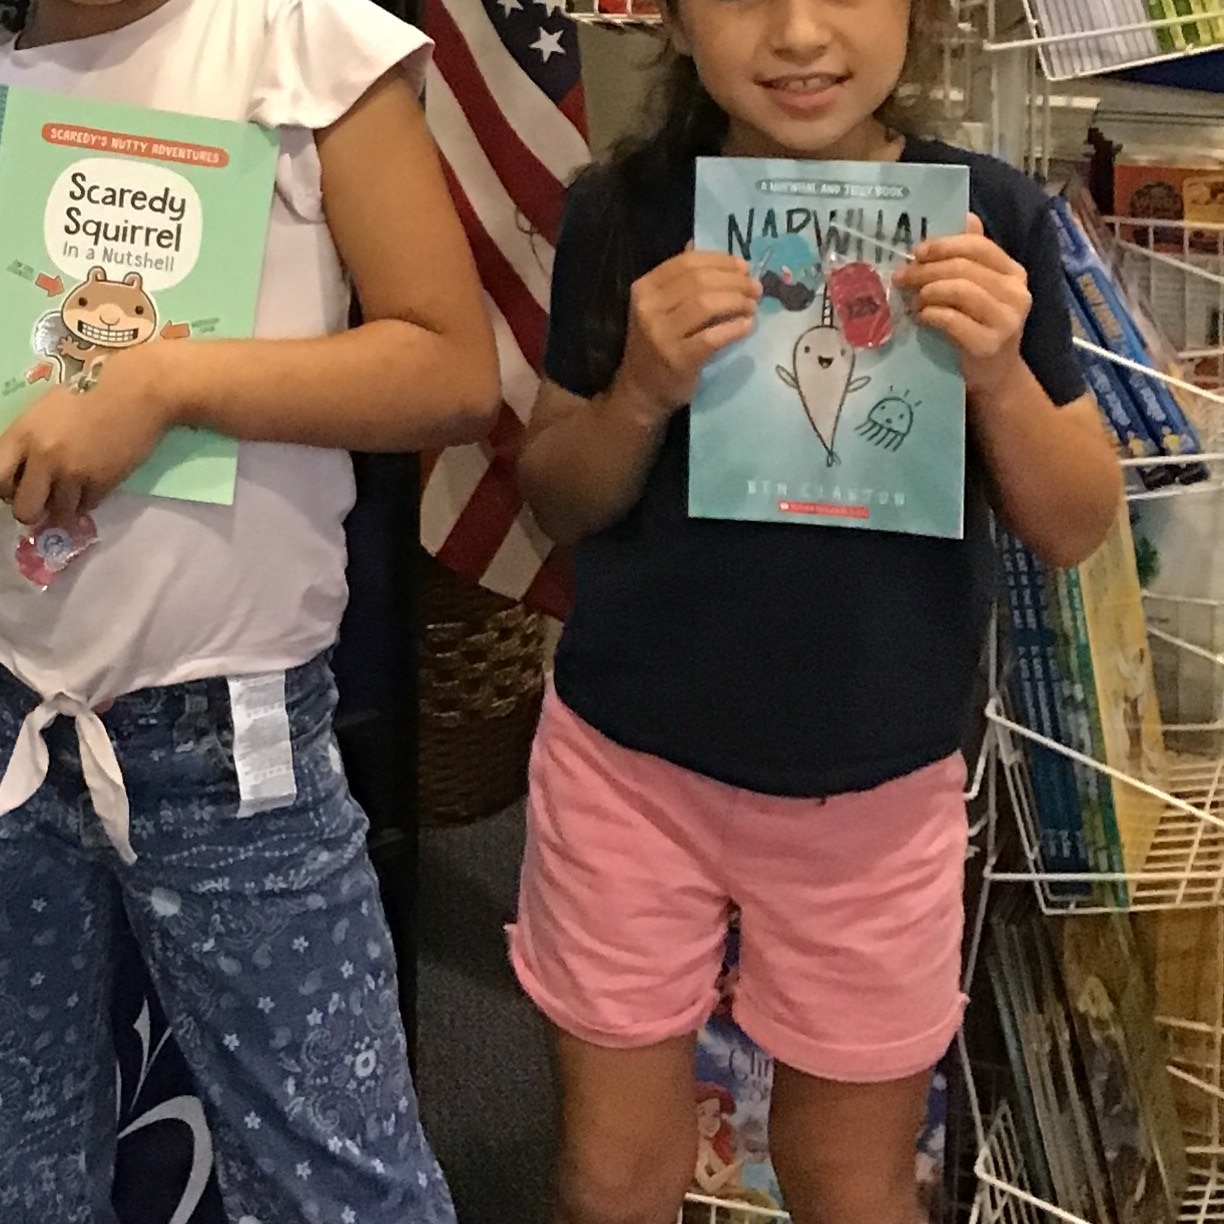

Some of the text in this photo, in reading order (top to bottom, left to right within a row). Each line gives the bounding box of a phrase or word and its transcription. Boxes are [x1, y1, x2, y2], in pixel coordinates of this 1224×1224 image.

[49, 126, 220, 164] SCAREDY'S NUTTY ADVENTURES
[69, 172, 186, 221] Scaredy
[64, 207, 182, 252] Squirrel
[86, 248, 95, 261] a
[102, 247, 174, 272] Nutshell
